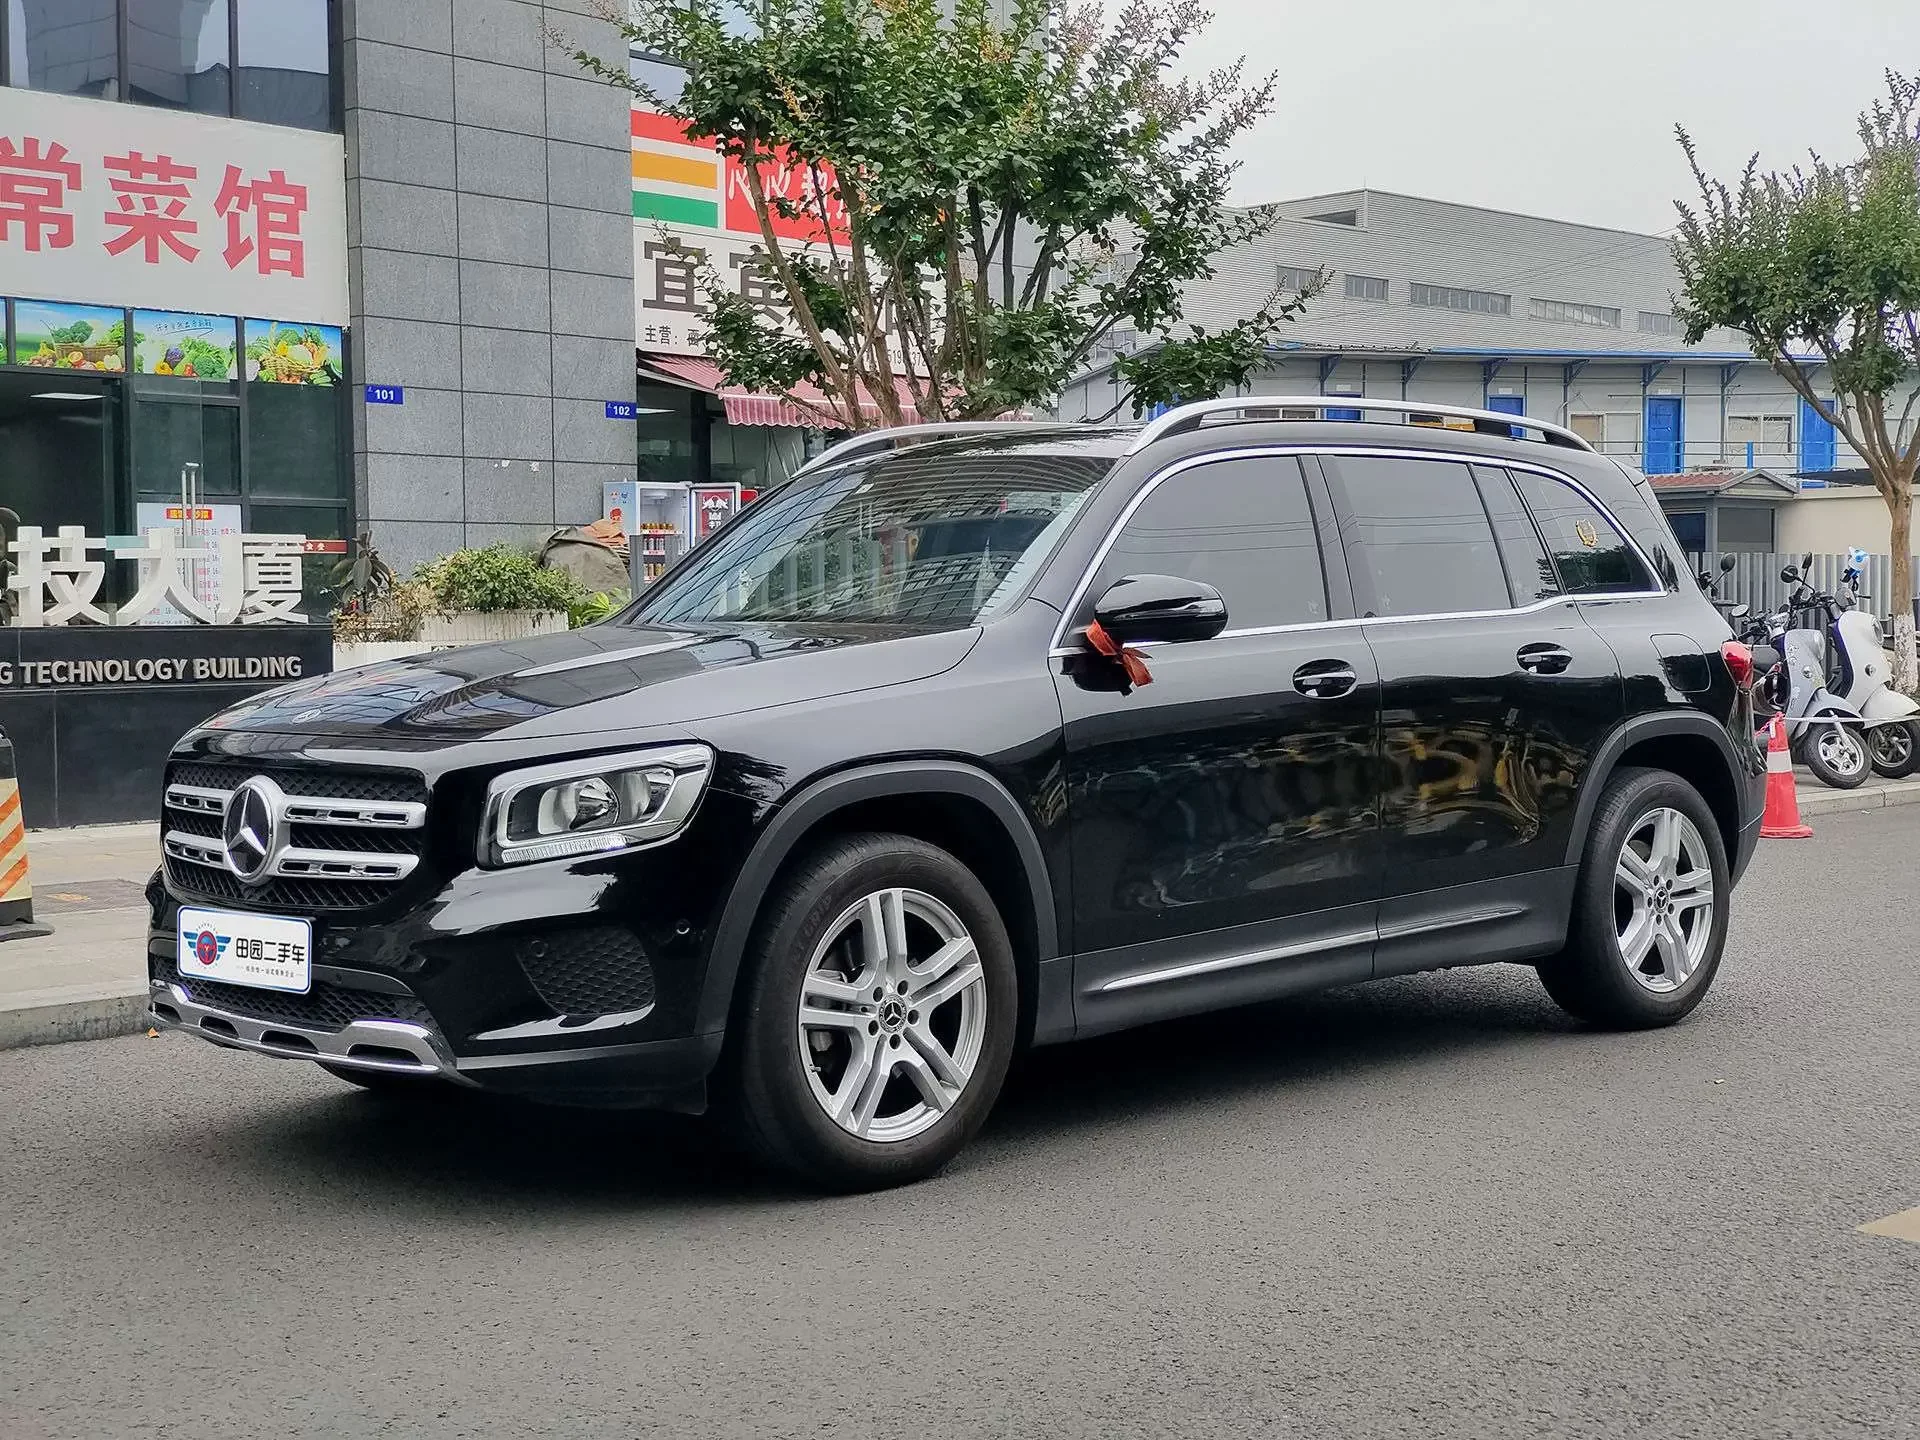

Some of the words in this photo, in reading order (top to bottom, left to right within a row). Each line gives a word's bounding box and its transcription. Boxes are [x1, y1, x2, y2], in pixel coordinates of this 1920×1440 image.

[0, 136, 308, 278] 常菜馆
[374, 389, 394, 400] 101
[613, 405, 630, 416] 102
[6, 525, 308, 627] 技大厦
[19, 658, 188, 684] TECHNOLOGY
[193, 656, 302, 680] BUILDING
[236, 937, 304, 964] 田园二手车
